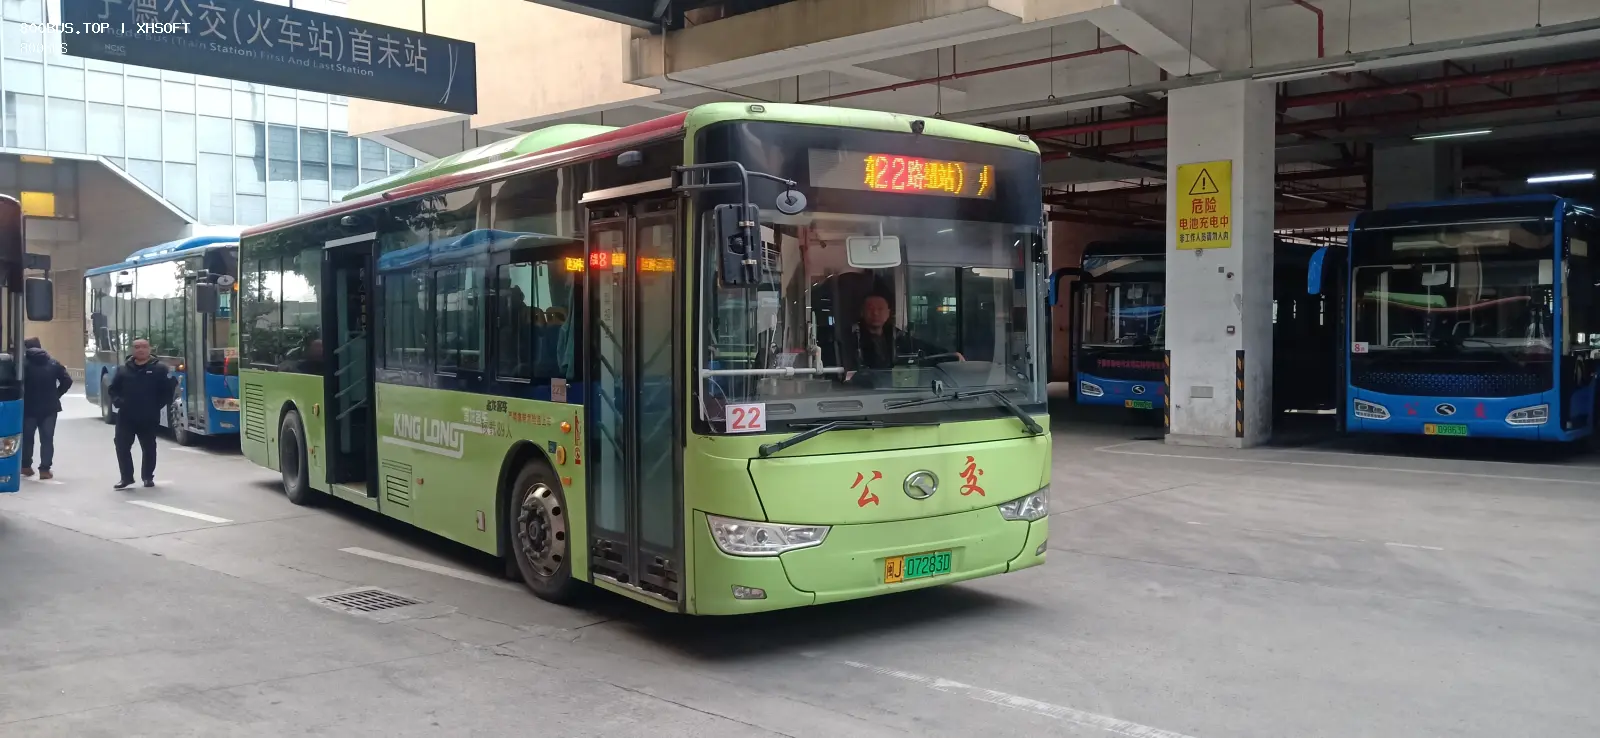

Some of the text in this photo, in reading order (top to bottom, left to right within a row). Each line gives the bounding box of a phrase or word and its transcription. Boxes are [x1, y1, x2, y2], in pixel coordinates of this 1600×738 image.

[210, 42, 256, 59] Station)
[260, 52, 285, 64] First
[287, 56, 310, 68] And
[1192, 197, 1217, 214] 危险
[1179, 215, 1229, 230] 电池充电中
[1179, 231, 1229, 243] 非工作人员请勿入内
[731, 406, 761, 430] 22
[394, 413, 460, 450] KING LONG
[850, 455, 986, 508] 公 交
